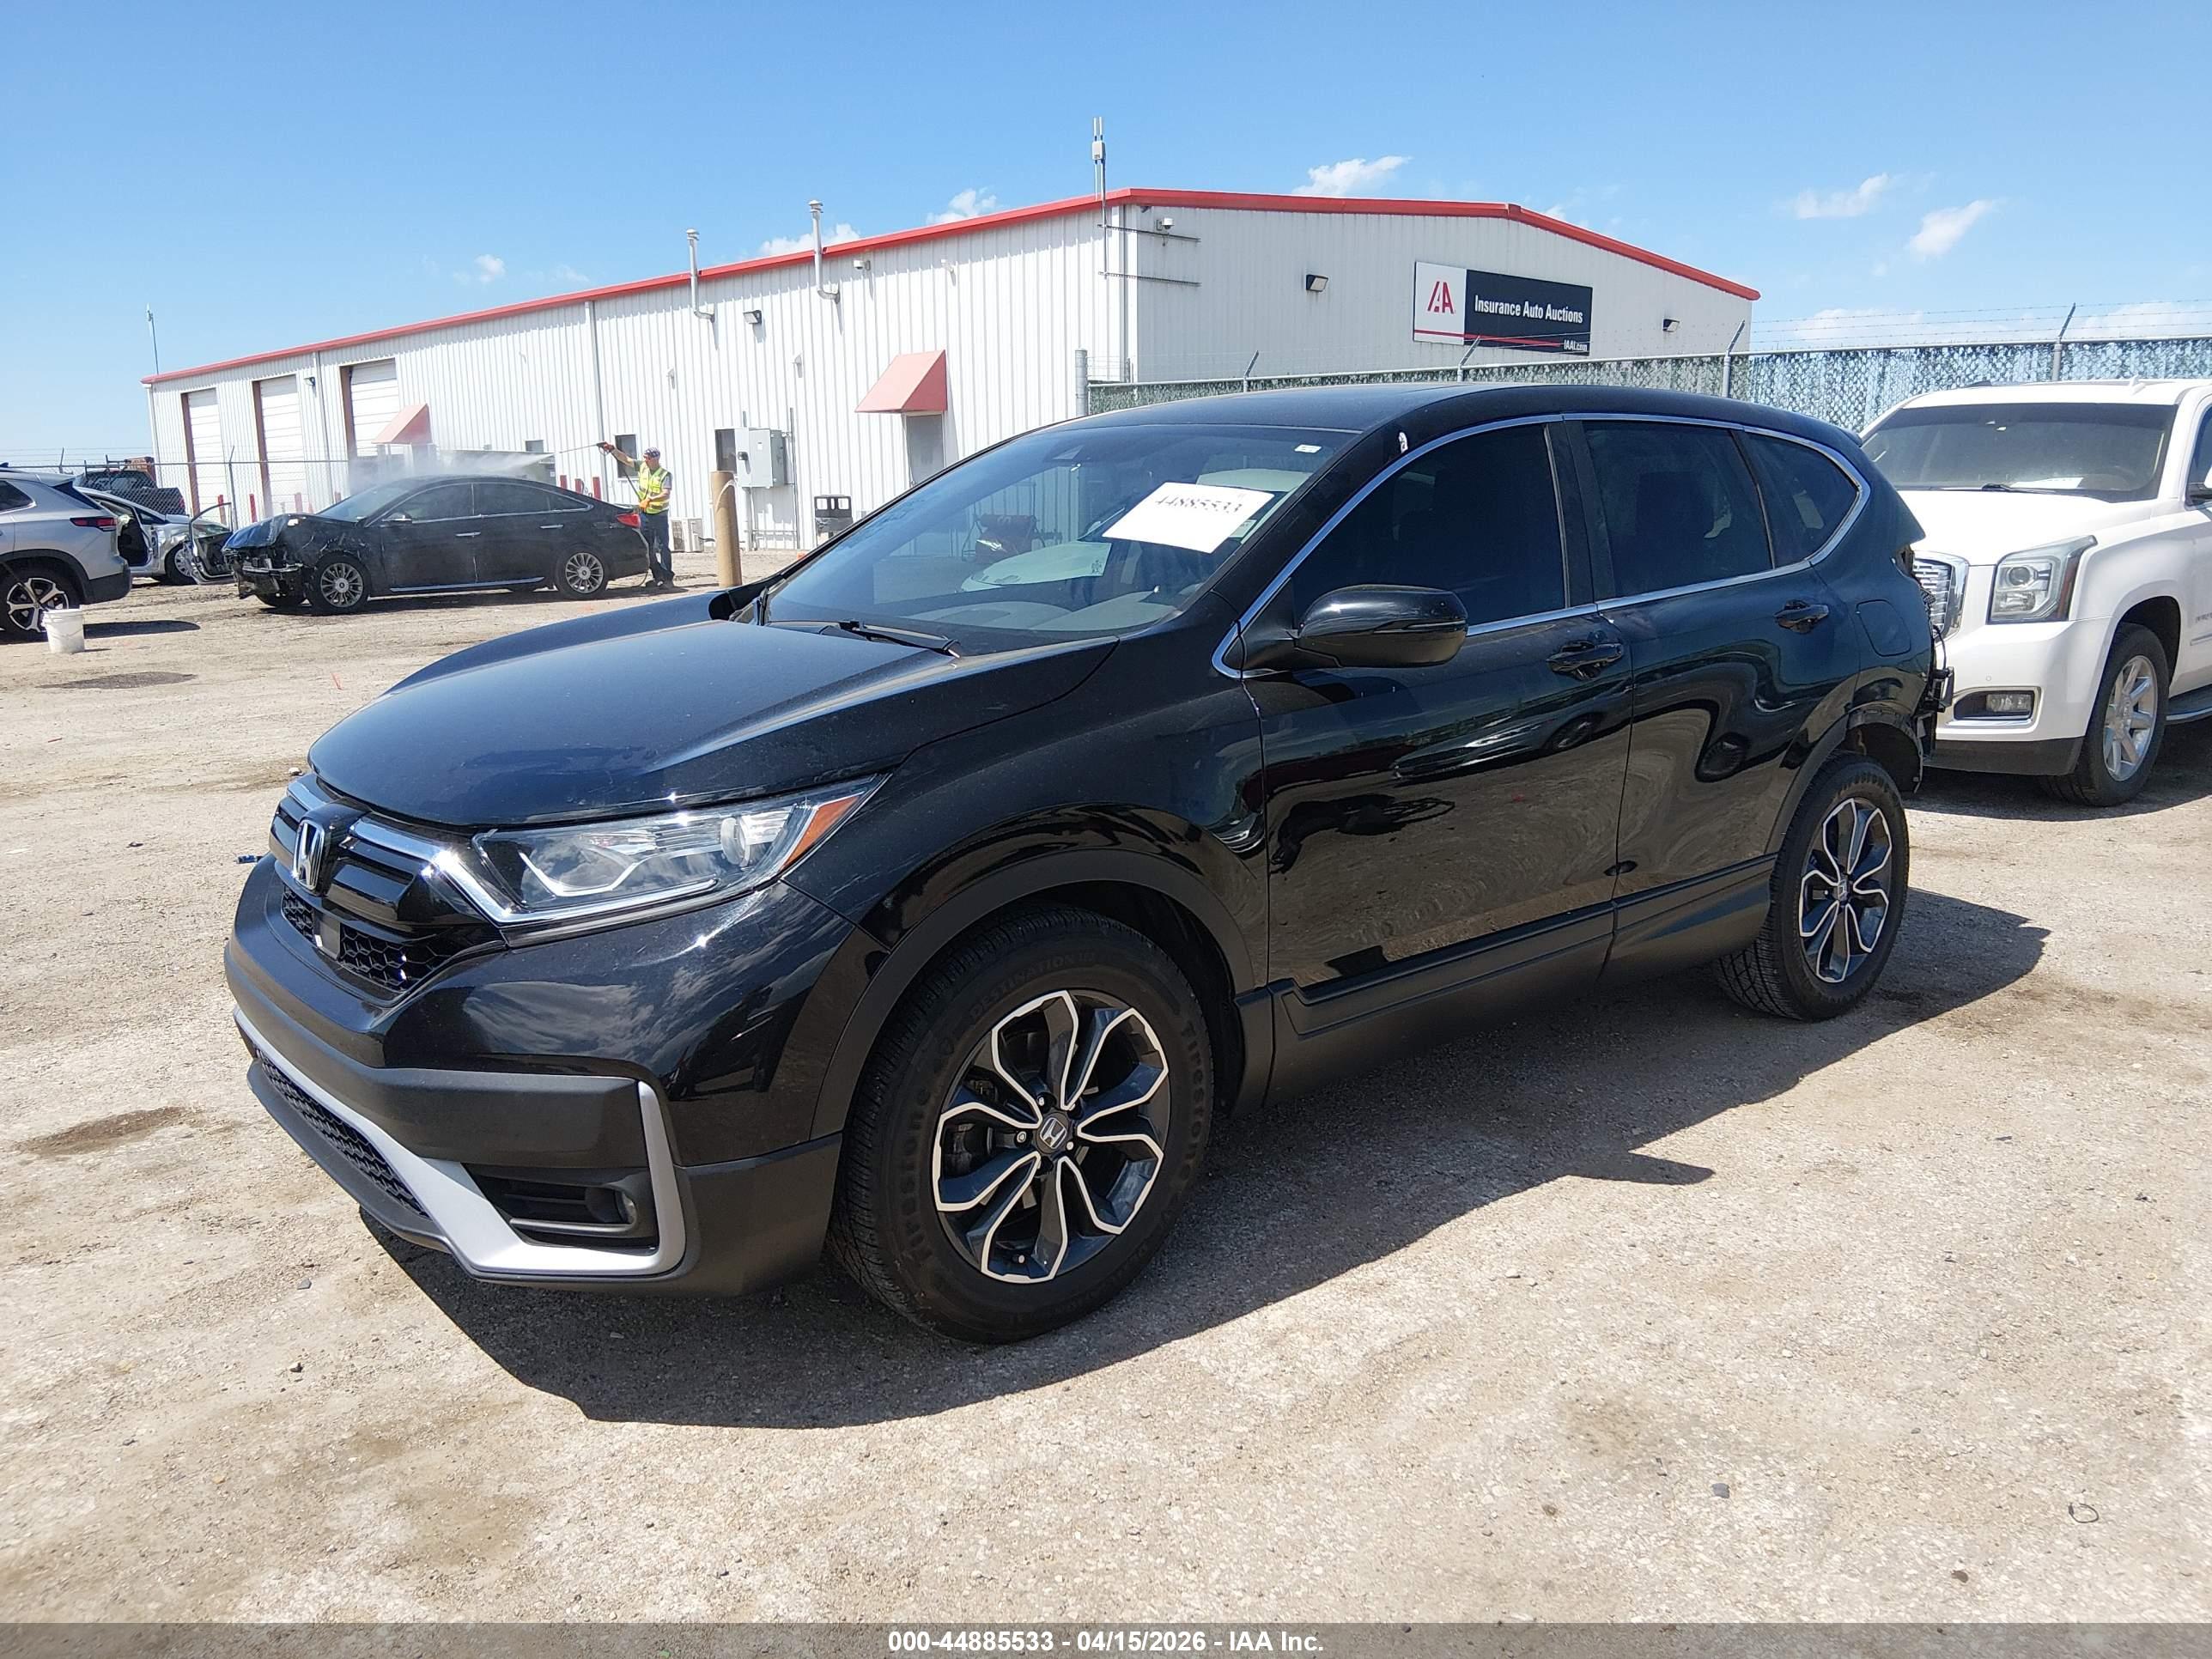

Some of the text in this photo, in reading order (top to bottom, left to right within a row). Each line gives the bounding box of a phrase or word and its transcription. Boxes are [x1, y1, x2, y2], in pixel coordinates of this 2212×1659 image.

[1474, 295, 1583, 324] Insurance Auto Auctions
[1155, 495, 1243, 514] 44885533
